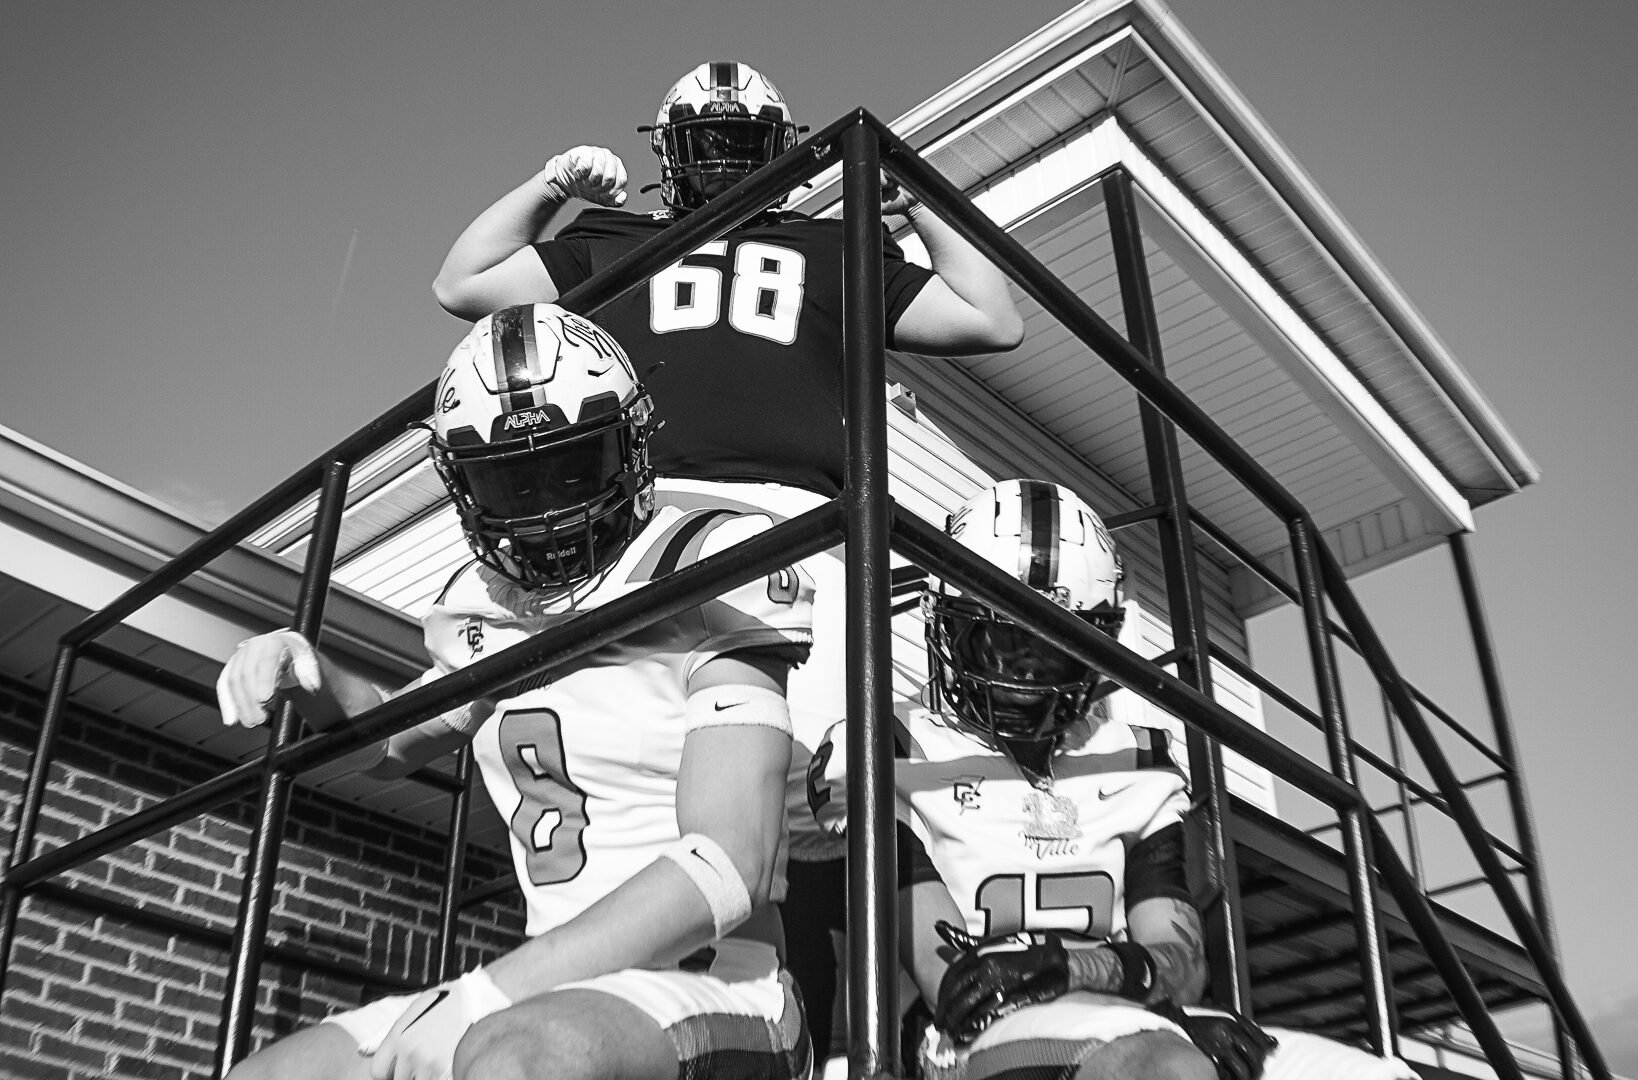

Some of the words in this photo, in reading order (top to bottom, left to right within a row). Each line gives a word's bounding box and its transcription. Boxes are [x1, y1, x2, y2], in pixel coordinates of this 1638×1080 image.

[710, 102, 741, 113] ALPHA
[650, 240, 806, 346] 68
[504, 409, 551, 430] ALPHA
[499, 707, 590, 886] 8
[1036, 838, 1079, 860] Ville
